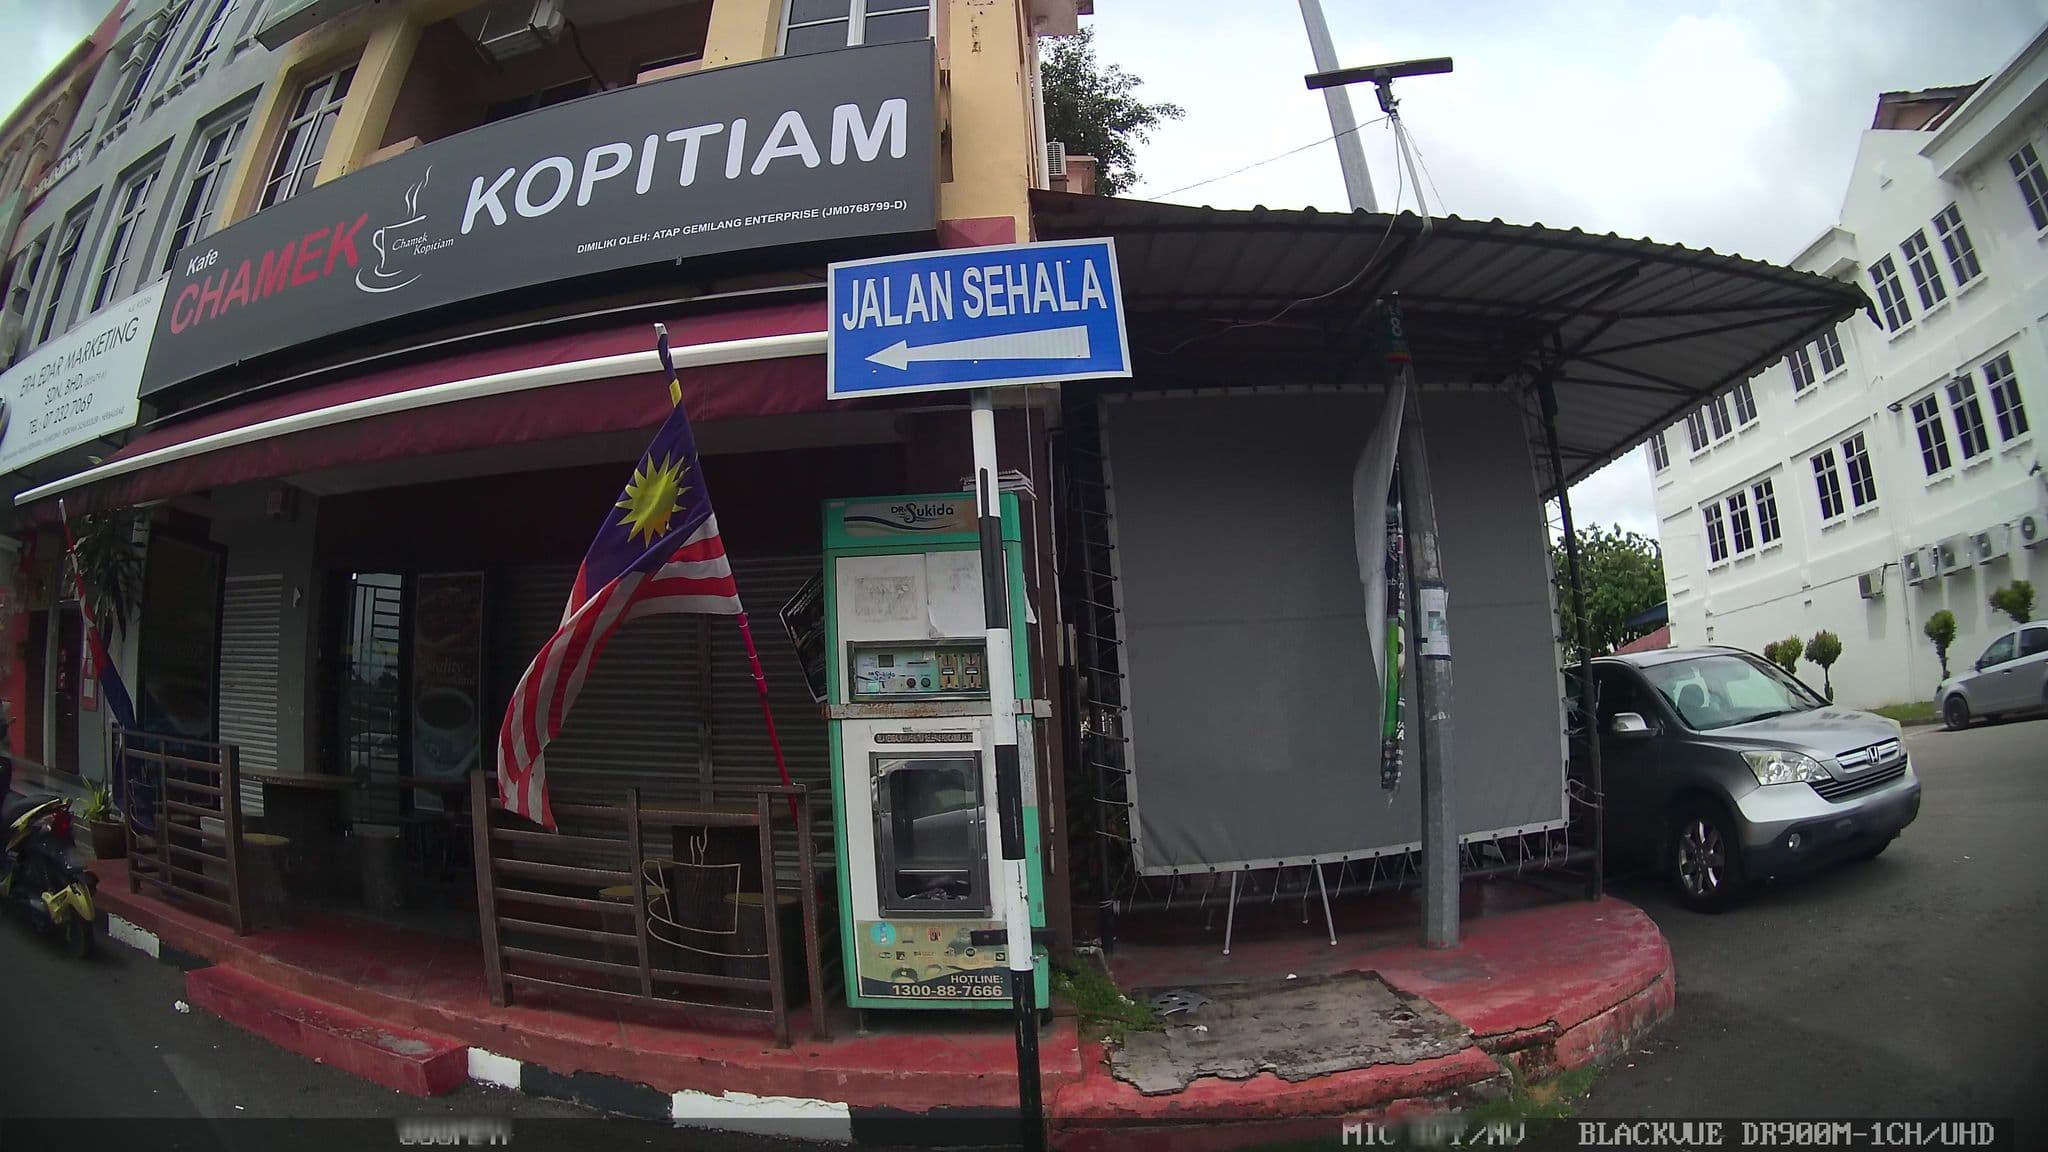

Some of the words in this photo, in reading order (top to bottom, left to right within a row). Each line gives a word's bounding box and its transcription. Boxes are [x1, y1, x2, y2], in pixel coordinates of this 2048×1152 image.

[170, 213, 369, 334] CHAMEK
[460, 98, 907, 235] KOPITIAM
[577, 238, 617, 253] DIMILIKI
[619, 232, 651, 247] OLEH:
[652, 227, 680, 241] ATAP
[683, 217, 742, 235] GEMILANG
[745, 208, 819, 226] ENTERPRISE
[822, 200, 907, 218] (JM0768799-D)
[392, 231, 428, 251] Chamek
[413, 238, 454, 256] Kopitiam
[186, 249, 218, 277] Kafe
[842, 269, 953, 331] JALAN
[962, 259, 1108, 319] SEHALA
[64, 317, 139, 369] MARKETING
[904, 502, 954, 524] Sukida
[892, 984, 1003, 997] 1300-88-7666
[951, 975, 1004, 984] HOTLINE:
